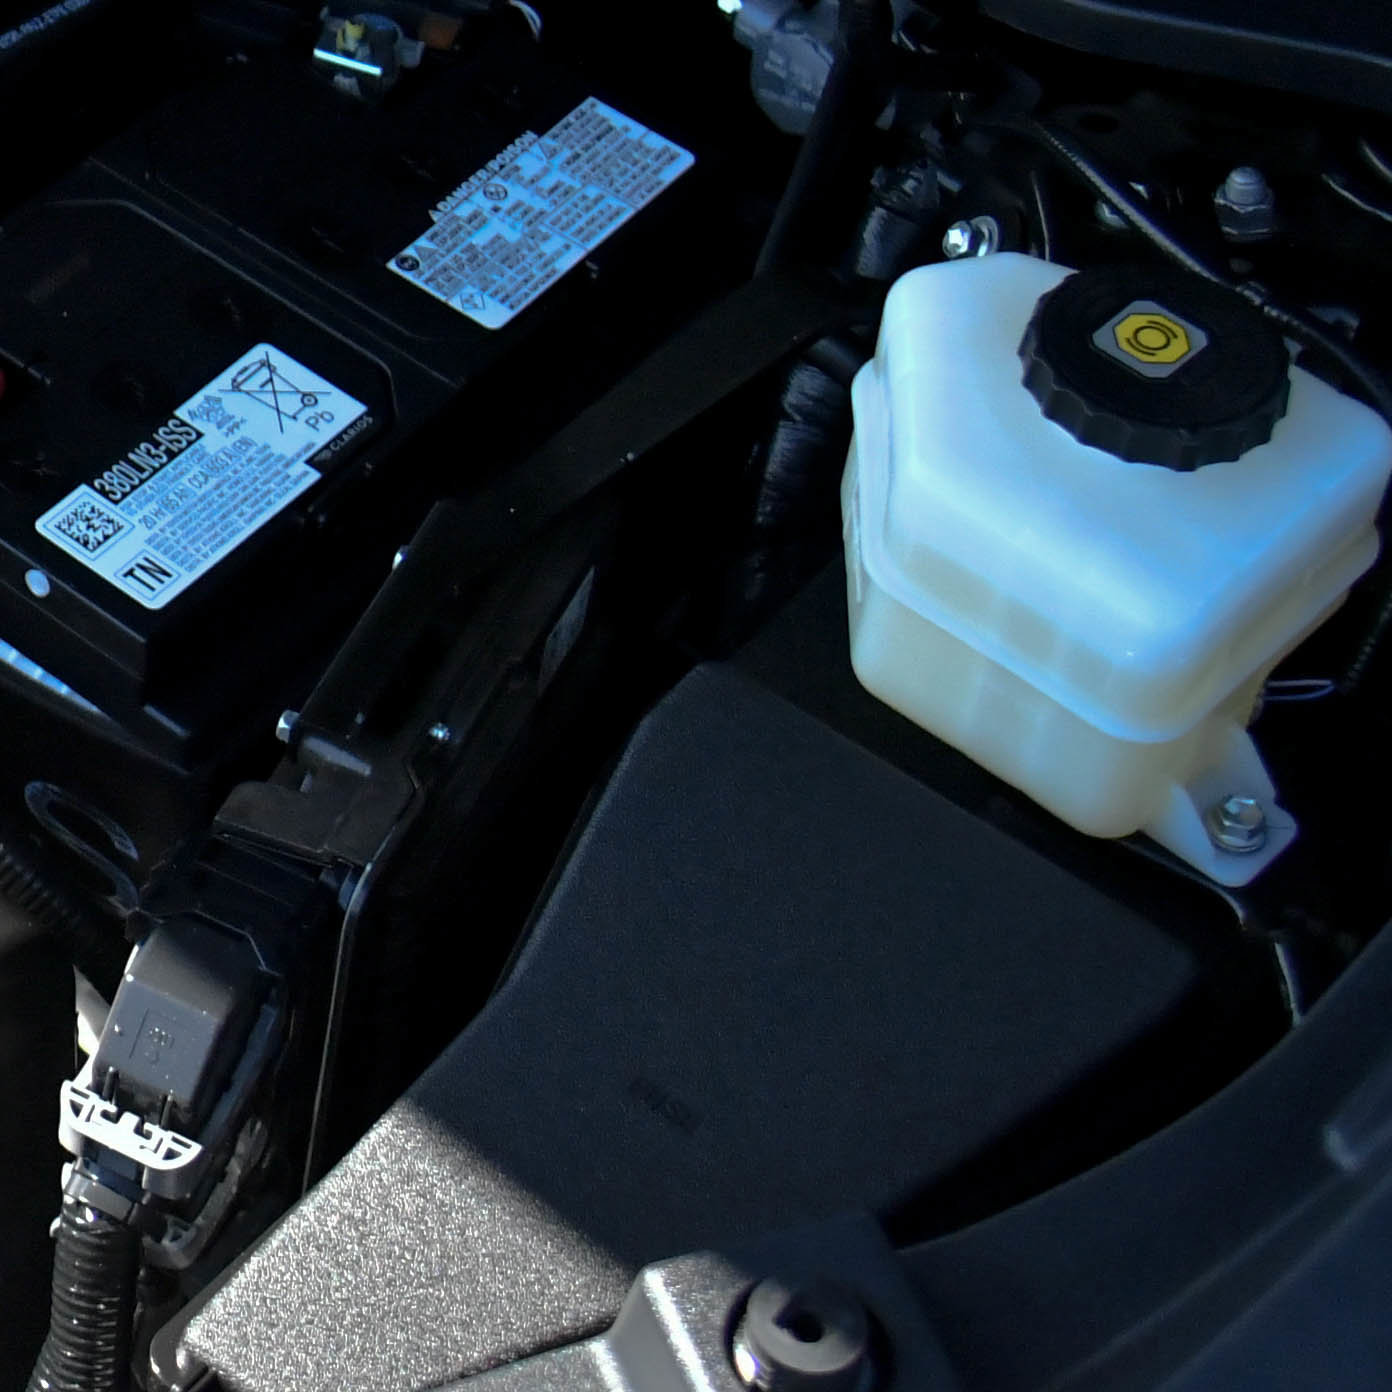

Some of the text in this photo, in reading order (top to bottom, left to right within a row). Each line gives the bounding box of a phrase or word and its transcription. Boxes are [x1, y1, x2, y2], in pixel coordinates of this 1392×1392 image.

[305, 410, 335, 432] Pb
[329, 415, 373, 453] CLARIOS
[94, 418, 196, 502] 380LN3-ISS
[122, 556, 174, 592] TN
